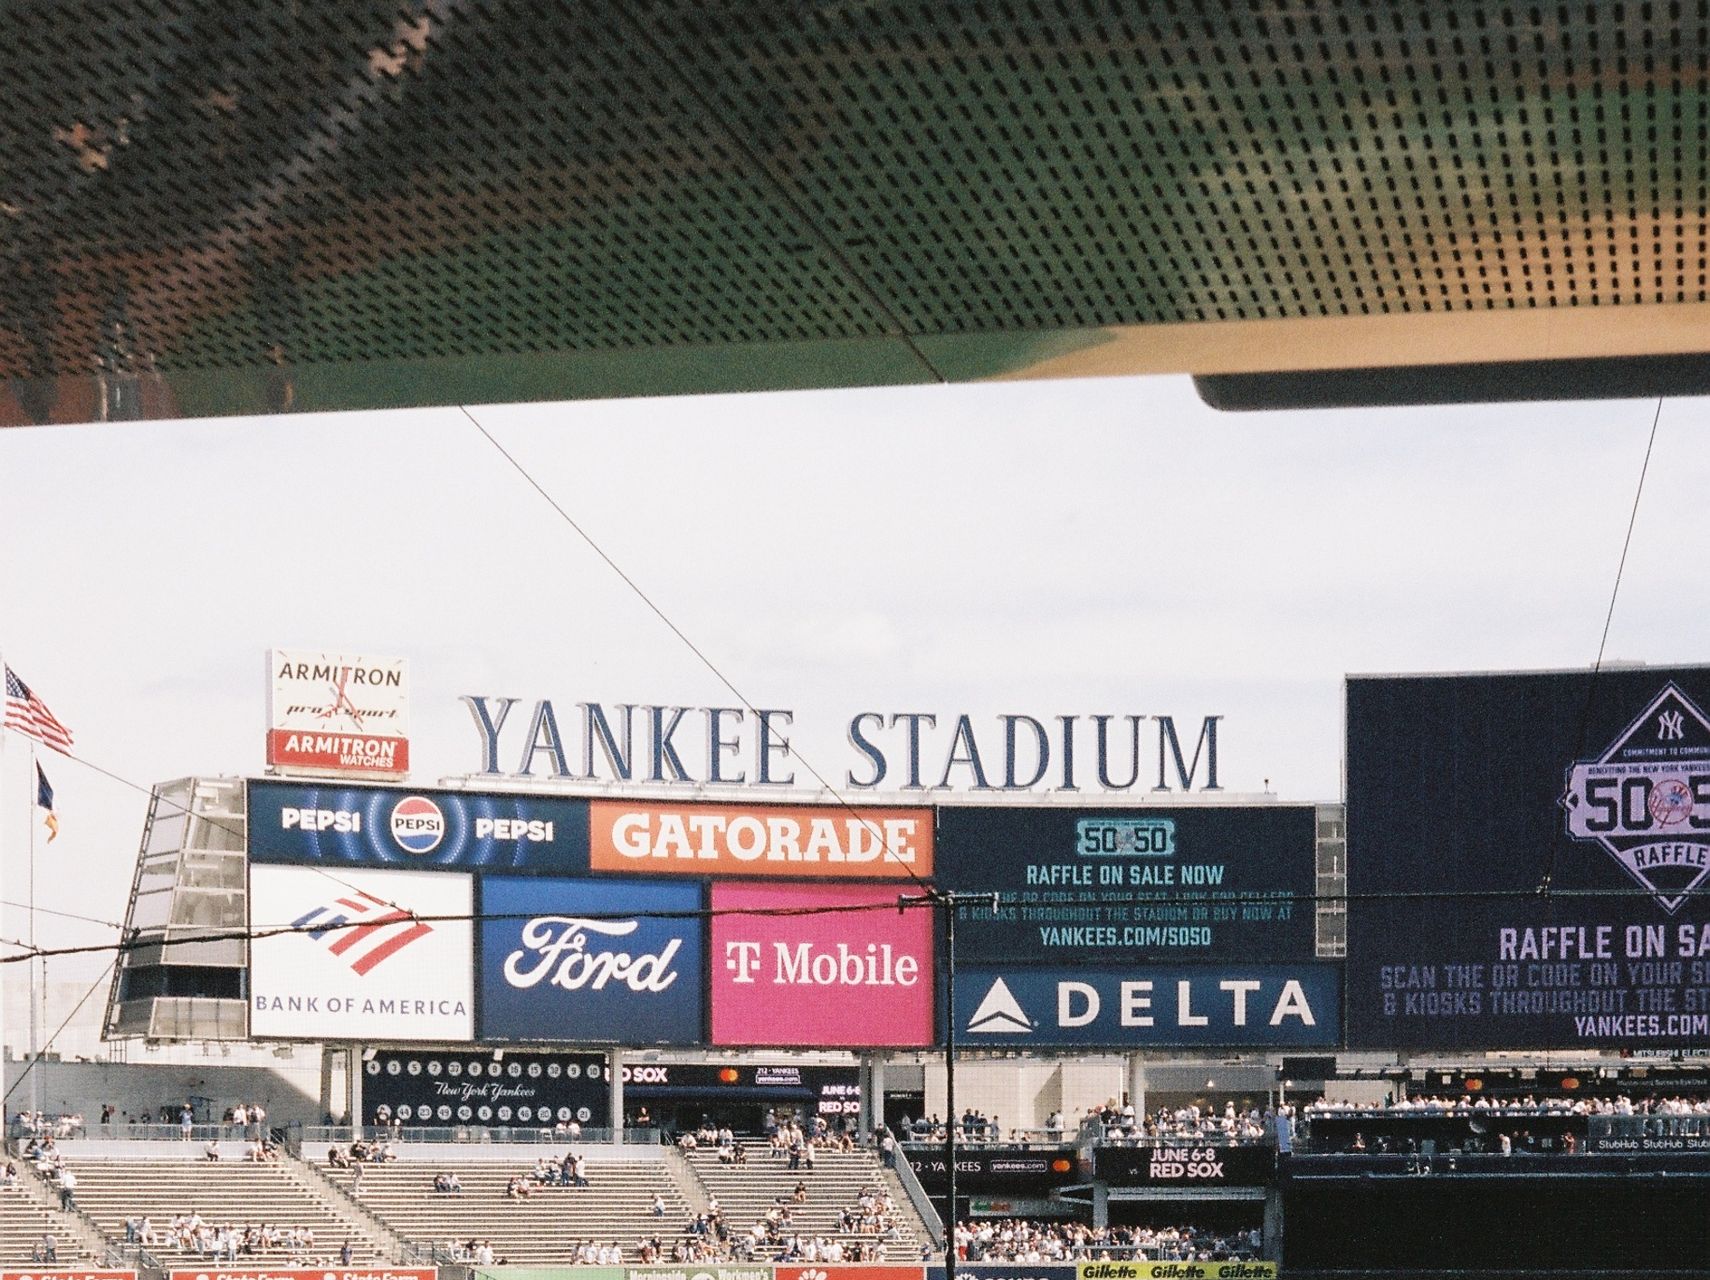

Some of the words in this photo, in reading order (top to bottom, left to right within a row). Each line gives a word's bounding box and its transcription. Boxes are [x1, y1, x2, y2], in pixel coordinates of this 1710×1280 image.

[278, 662, 401, 687] ARMITRON
[1657, 710, 1684, 740] NY
[285, 735, 396, 757] ARMITRON
[459, 694, 796, 786] YANKEE
[845, 712, 1225, 793] STADIUM
[339, 754, 394, 768] WATCHES
[1585, 777, 1654, 832] 50
[281, 806, 361, 833] PEPSI
[395, 816, 440, 832] PEPSI
[476, 817, 554, 843] PEPSI
[611, 812, 916, 863] GATORADE
[1084, 827, 1118, 853] 50
[1133, 827, 1167, 853] 50
[1634, 844, 1710, 867] RAFFLE
[1026, 865, 1092, 885] RAFFLE
[1099, 865, 1123, 885] ON
[1129, 865, 1174, 885] SALE
[1181, 865, 1225, 885] NOW
[1105, 906, 1129, 921] THE
[1277, 906, 1293, 921] AT
[1499, 926, 1612, 961] RAFFLE
[1624, 925, 1666, 958] ON
[503, 916, 683, 993] Ford
[773, 942, 919, 985] Mobile
[1380, 965, 1436, 989] SCAN
[1444, 965, 1485, 989] THE
[1527, 963, 1582, 987] CODE
[1589, 963, 1619, 986] ON
[1626, 961, 1682, 985] YOUR
[256, 995, 319, 1013] BANK
[326, 997, 355, 1015] OF
[362, 998, 467, 1017] AMERICA
[1058, 980, 1316, 1027] DELTA
[1404, 991, 1481, 1015] KIOSKS
[1489, 990, 1628, 1015] THROUGHOUT
[1637, 989, 1676, 1013] THE
[634, 1067, 668, 1083] SOX
[433, 1081, 461, 1096] New
[461, 1082, 490, 1102] York
[489, 1082, 536, 1103] Yankees
[821, 1085, 846, 1096] JUNE
[818, 1101, 842, 1114] RED
[842, 1102, 861, 1114] SO
[1151, 1148, 1188, 1164] JUNE
[1190, 1148, 1216, 1163] 6-8
[1598, 1140, 1640, 1150] StubHub
[1642, 1140, 1684, 1150] StubHub
[909, 1161, 922, 1173] 12
[930, 1161, 982, 1173] YAKEES
[992, 1162, 1045, 1172] yankees.com
[1149, 1162, 1184, 1179] RED
[1187, 1162, 1224, 1179] SOX
[1083, 1264, 1138, 1280] Gillette
[1151, 1264, 1206, 1280] Gillette
[1218, 1265, 1273, 1280] Gillette
